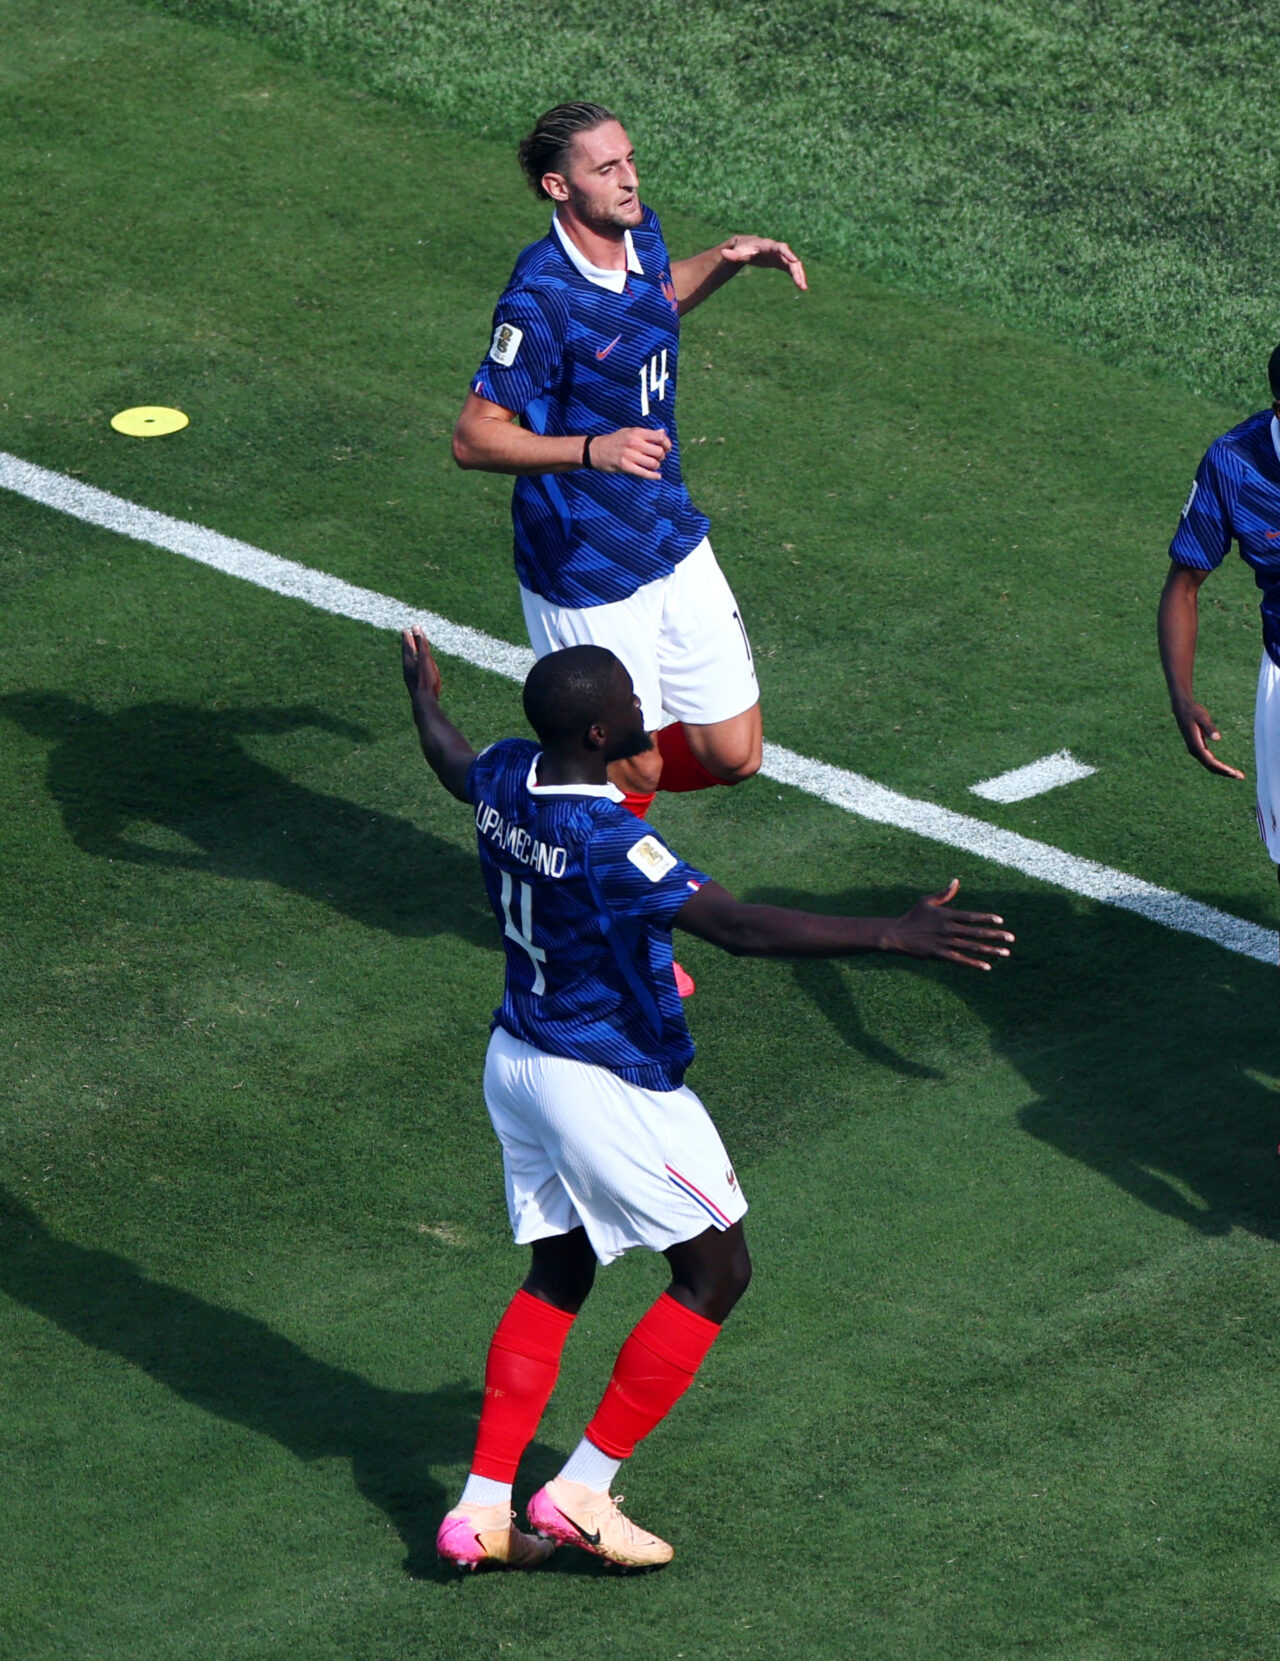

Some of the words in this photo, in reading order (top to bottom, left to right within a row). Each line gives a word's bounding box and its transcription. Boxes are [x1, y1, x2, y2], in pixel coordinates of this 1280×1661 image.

[638, 348, 669, 417] 14
[475, 800, 567, 879] UPAMECANO
[500, 869, 548, 998] 4
